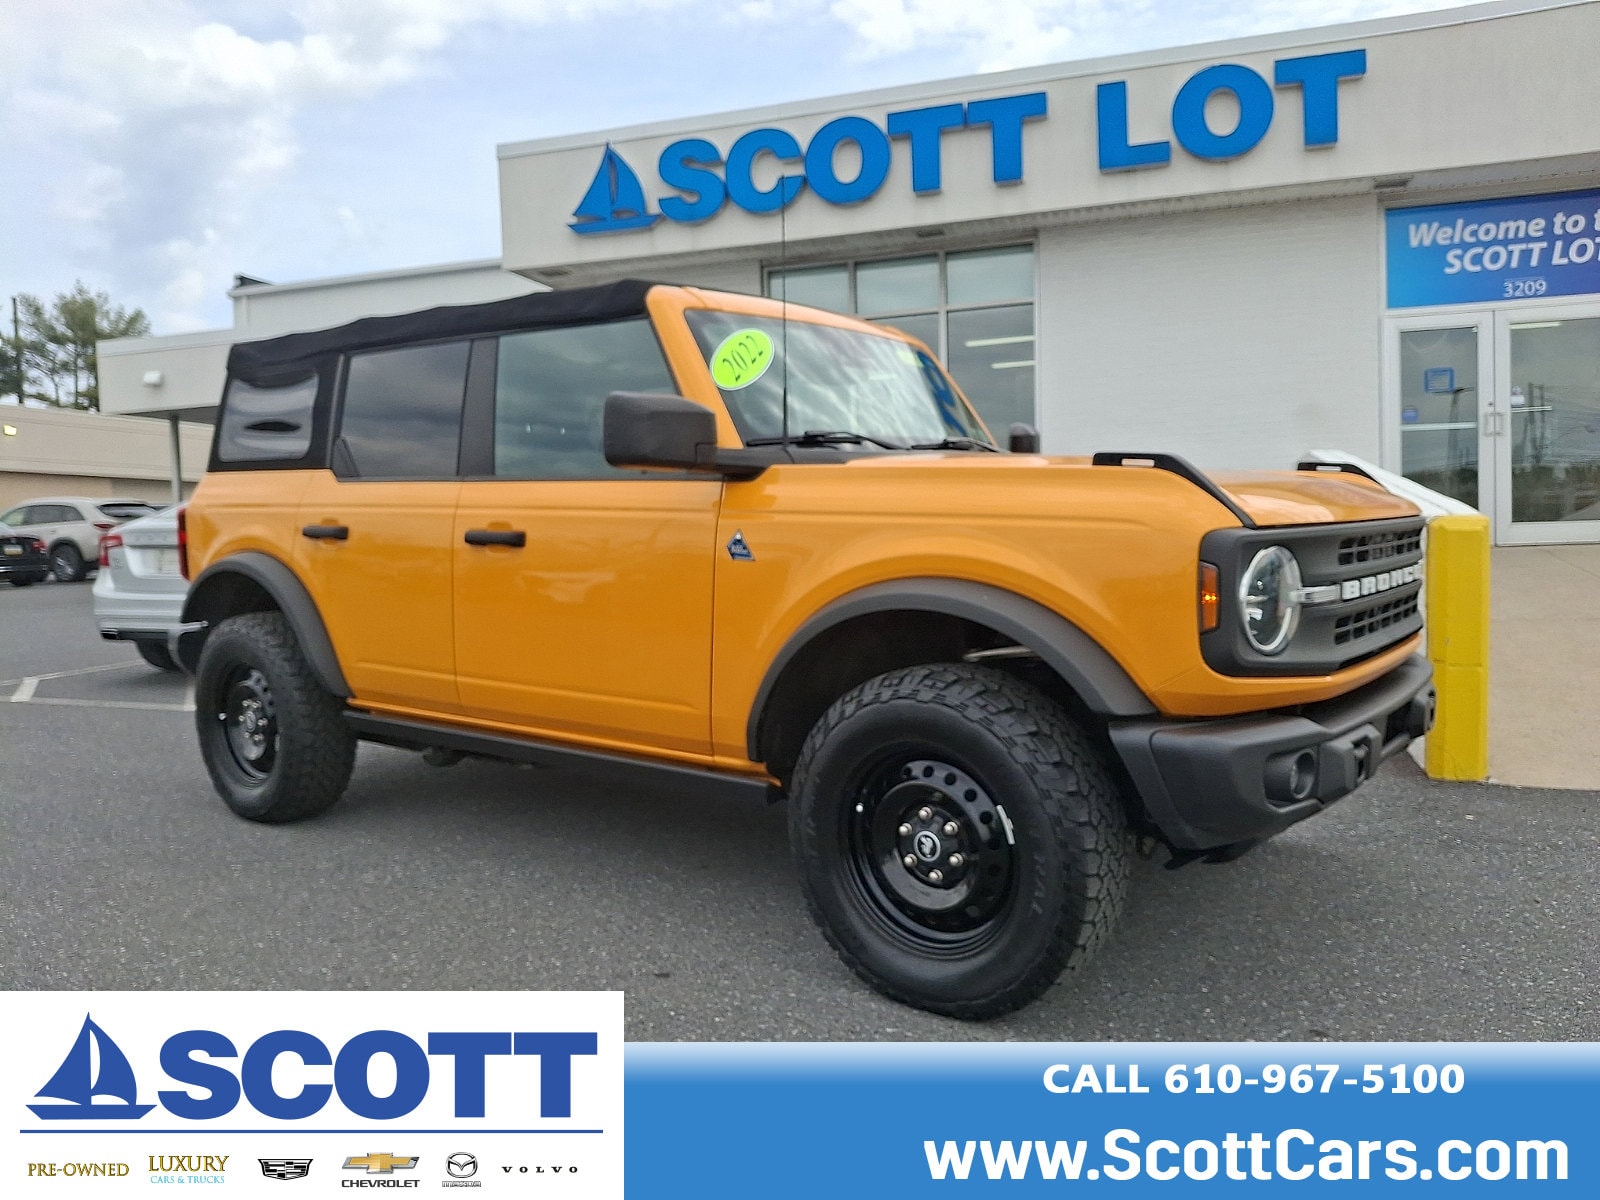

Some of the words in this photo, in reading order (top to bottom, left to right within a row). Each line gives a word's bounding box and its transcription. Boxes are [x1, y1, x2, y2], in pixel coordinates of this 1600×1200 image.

[658, 92, 1048, 222] SCOTT
[1096, 49, 1367, 172] LOT
[1408, 217, 1546, 248] Welcome
[1553, 211, 1586, 236] to
[1443, 241, 1548, 275] SCOTT
[1503, 279, 1547, 298] 3209
[722, 335, 764, 383] 2022
